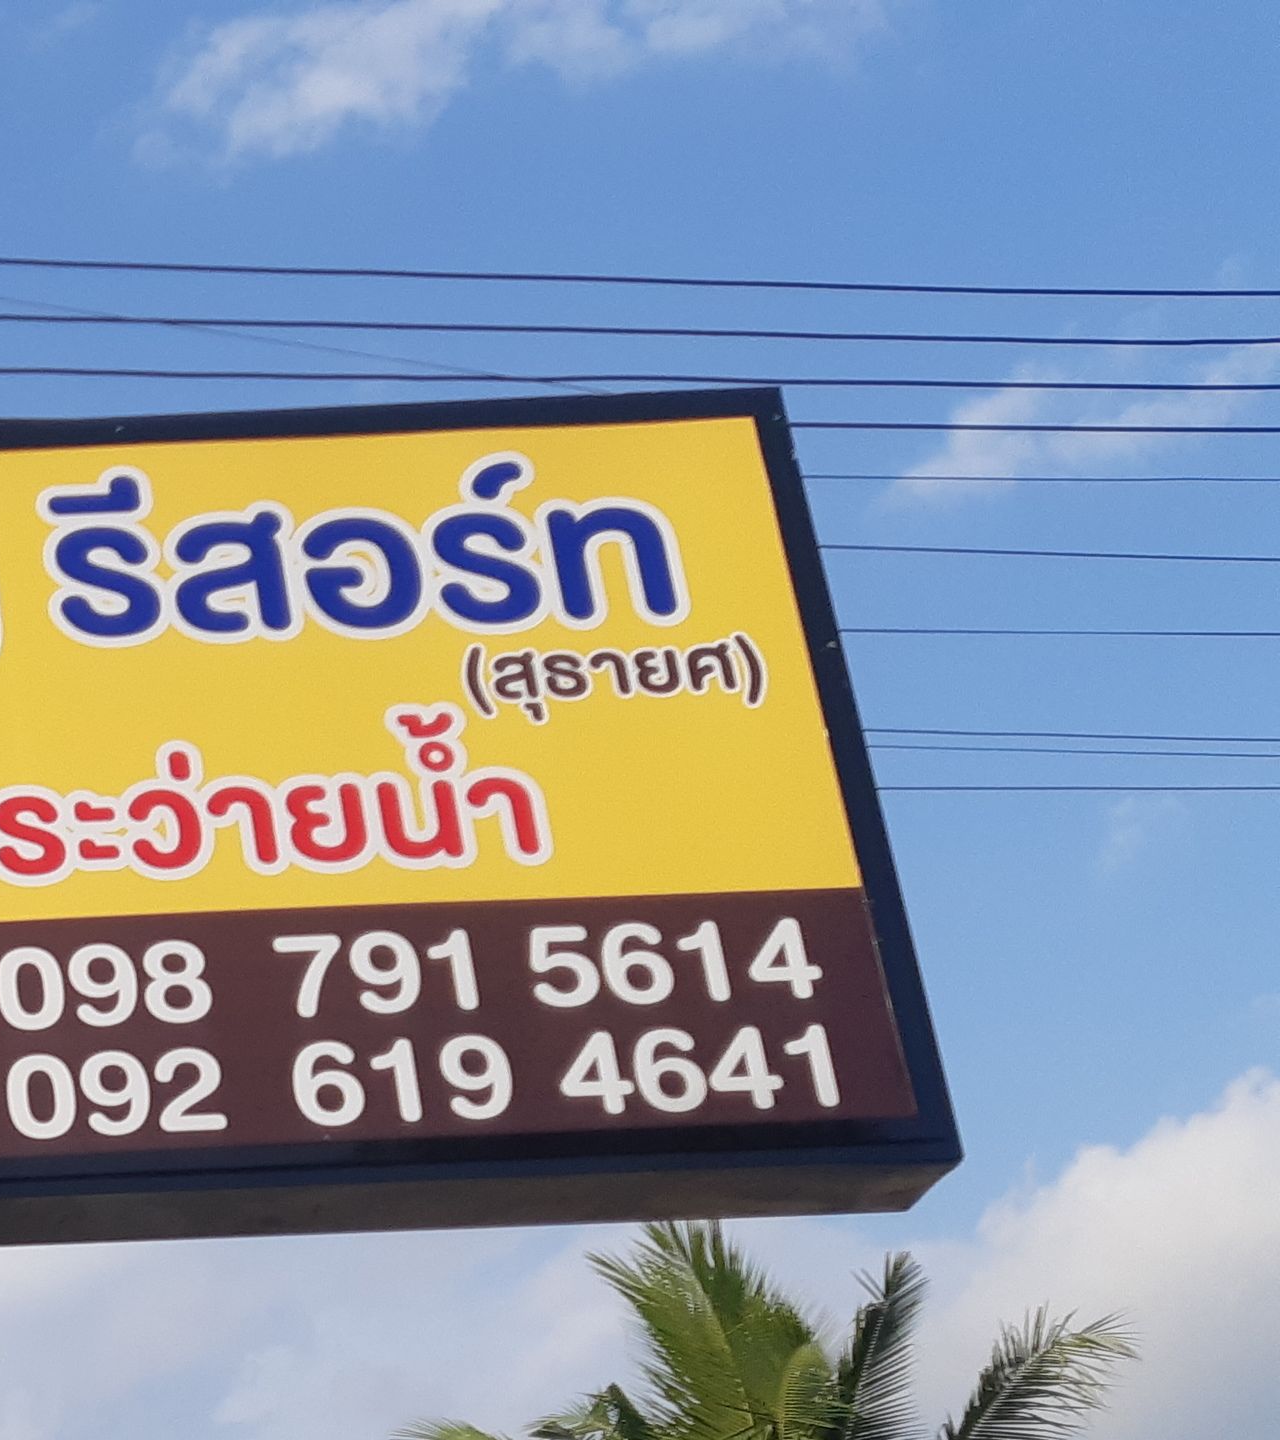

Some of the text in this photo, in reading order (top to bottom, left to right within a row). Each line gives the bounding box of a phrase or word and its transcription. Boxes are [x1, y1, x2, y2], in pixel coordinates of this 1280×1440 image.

[49, 462, 676, 637] รีสอร์ท
[465, 633, 763, 722] (สุธายศ)
[271, 928, 480, 1020] 791
[528, 916, 824, 1009] 5614
[5, 1023, 841, 1141] 092 619 4641
